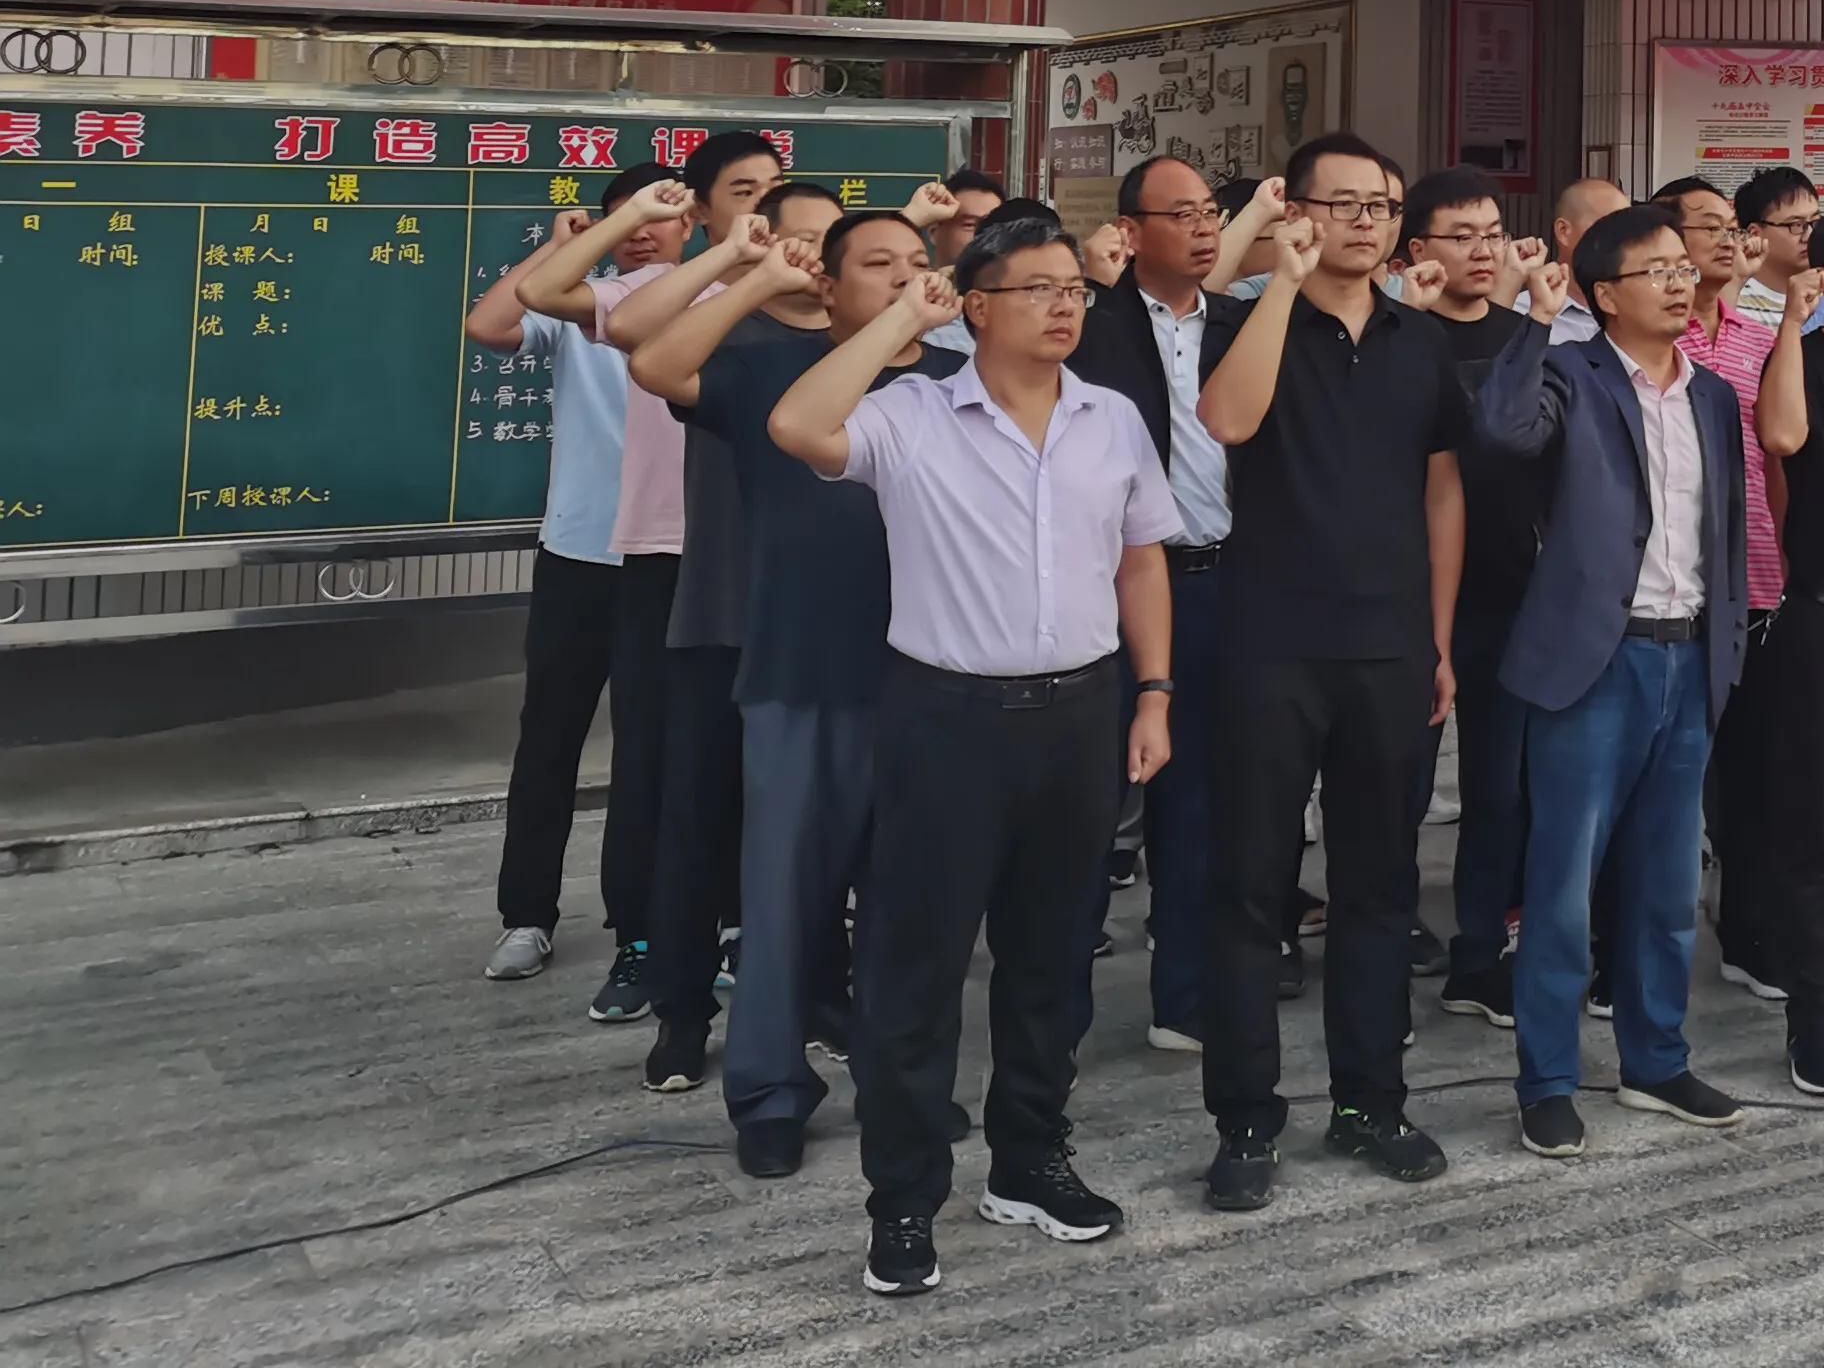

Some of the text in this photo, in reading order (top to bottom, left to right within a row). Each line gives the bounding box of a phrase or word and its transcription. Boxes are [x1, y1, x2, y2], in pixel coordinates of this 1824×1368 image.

[327, 173, 360, 203] 课
[549, 175, 867, 206] 教 栏
[107, 210, 136, 233] 组
[250, 213, 421, 235] 月 日 组
[522, 222, 545, 247] 本
[78, 242, 139, 267] 时间：
[204, 245, 294, 267] 授课人：
[369, 242, 425, 265] 时间：
[193, 394, 282, 421] 提升点：
[0, 498, 45, 520] 人：
[187, 483, 331, 512] 下周授课人：
